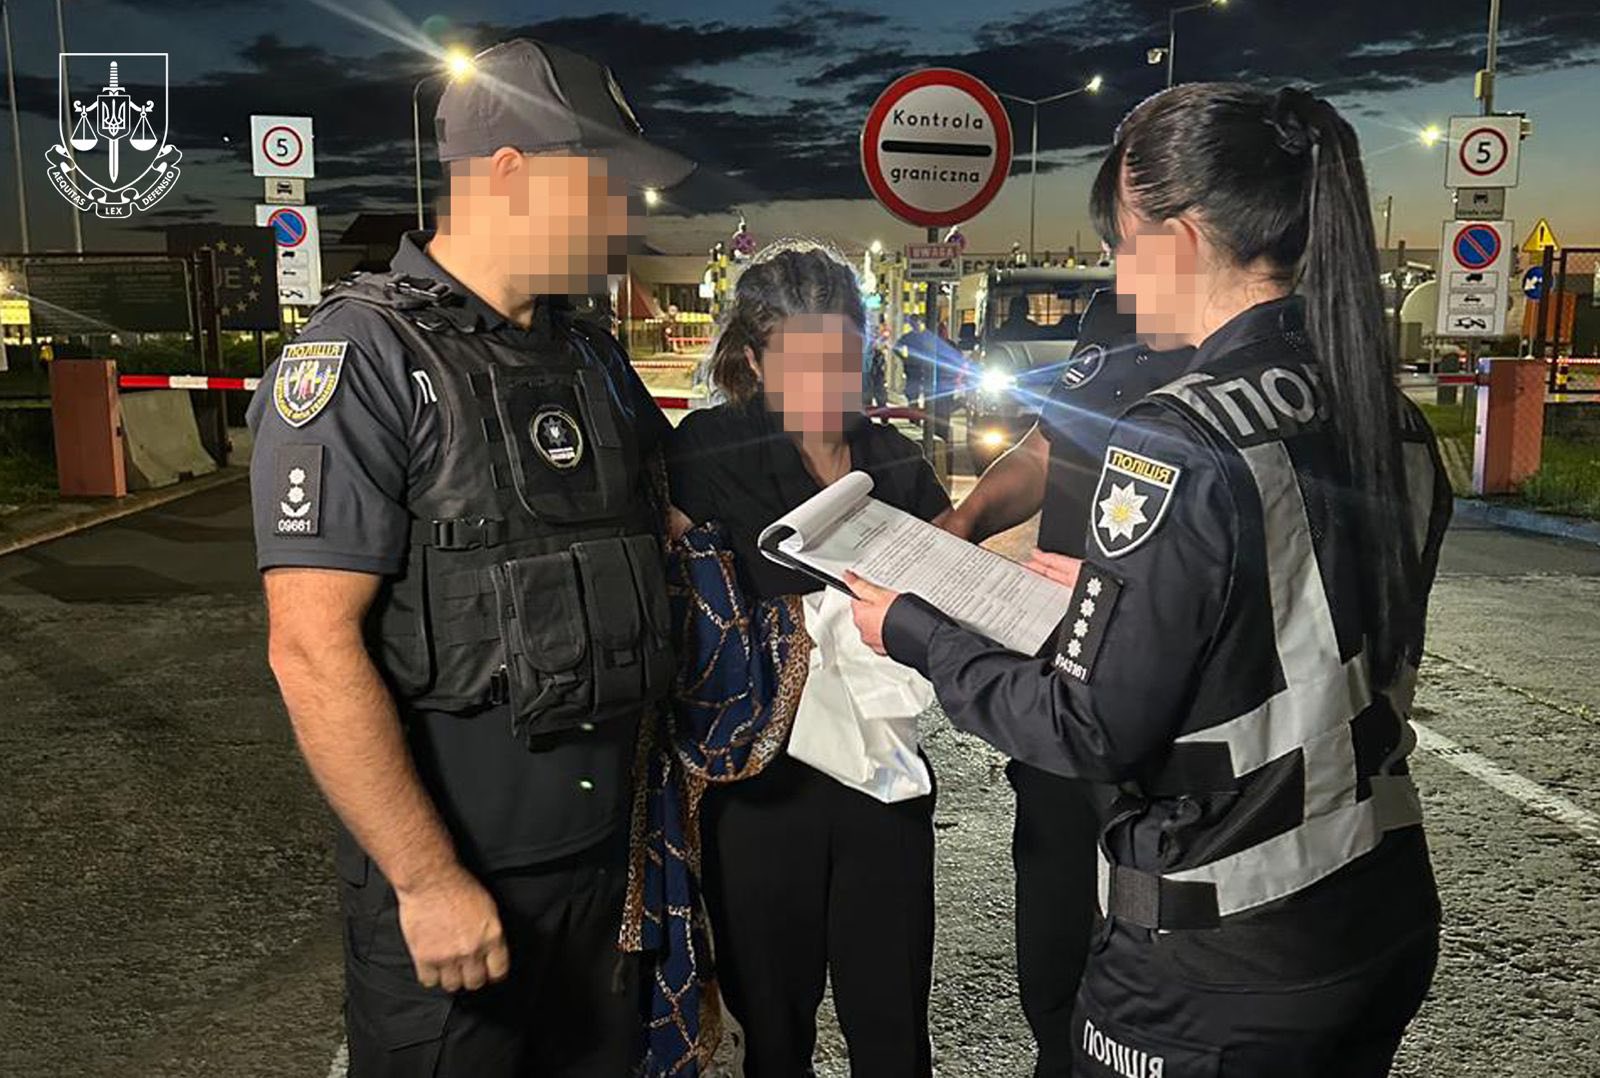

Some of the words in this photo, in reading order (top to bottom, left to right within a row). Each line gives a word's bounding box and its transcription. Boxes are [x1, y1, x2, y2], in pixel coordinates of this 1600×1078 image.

[893, 109, 983, 129] Kontrola
[276, 138, 288, 156] 5
[1476, 141, 1491, 164] 5
[890, 165, 980, 183] graniczna
[1111, 452, 1173, 484] ПОЛІЦІЯ
